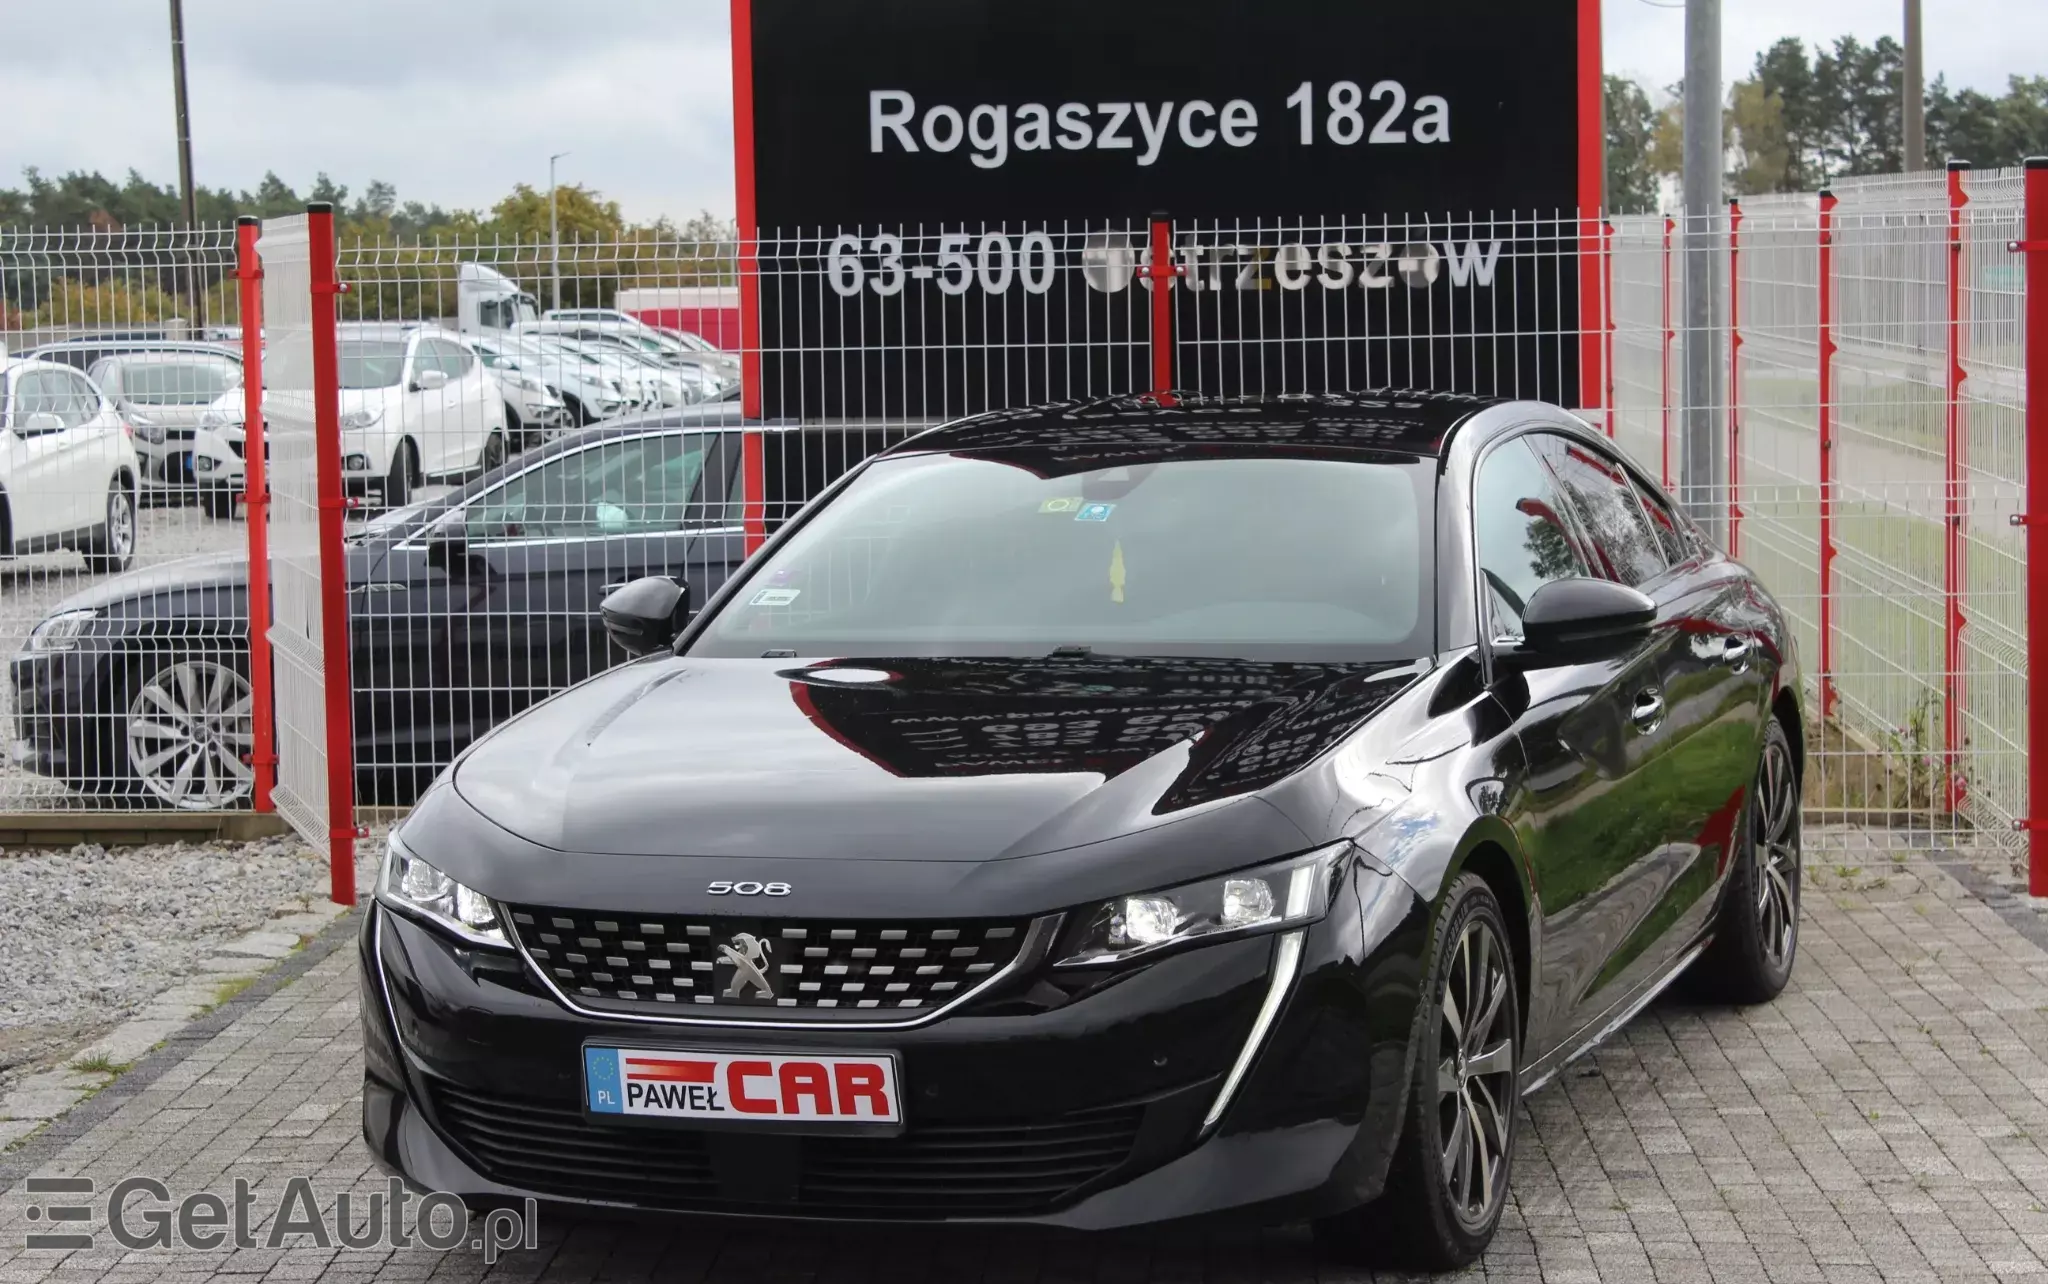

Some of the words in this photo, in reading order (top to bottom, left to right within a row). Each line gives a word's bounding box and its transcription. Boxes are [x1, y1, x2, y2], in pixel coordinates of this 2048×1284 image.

[868, 88, 1259, 169] Rogaszyce
[1286, 79, 1452, 146] 182a
[827, 231, 1056, 297] 63-500
[707, 880, 793, 896] 508
[597, 1090, 616, 1106] PL
[626, 1083, 725, 1112] PAWEŁ
[726, 1060, 890, 1116] CAR
